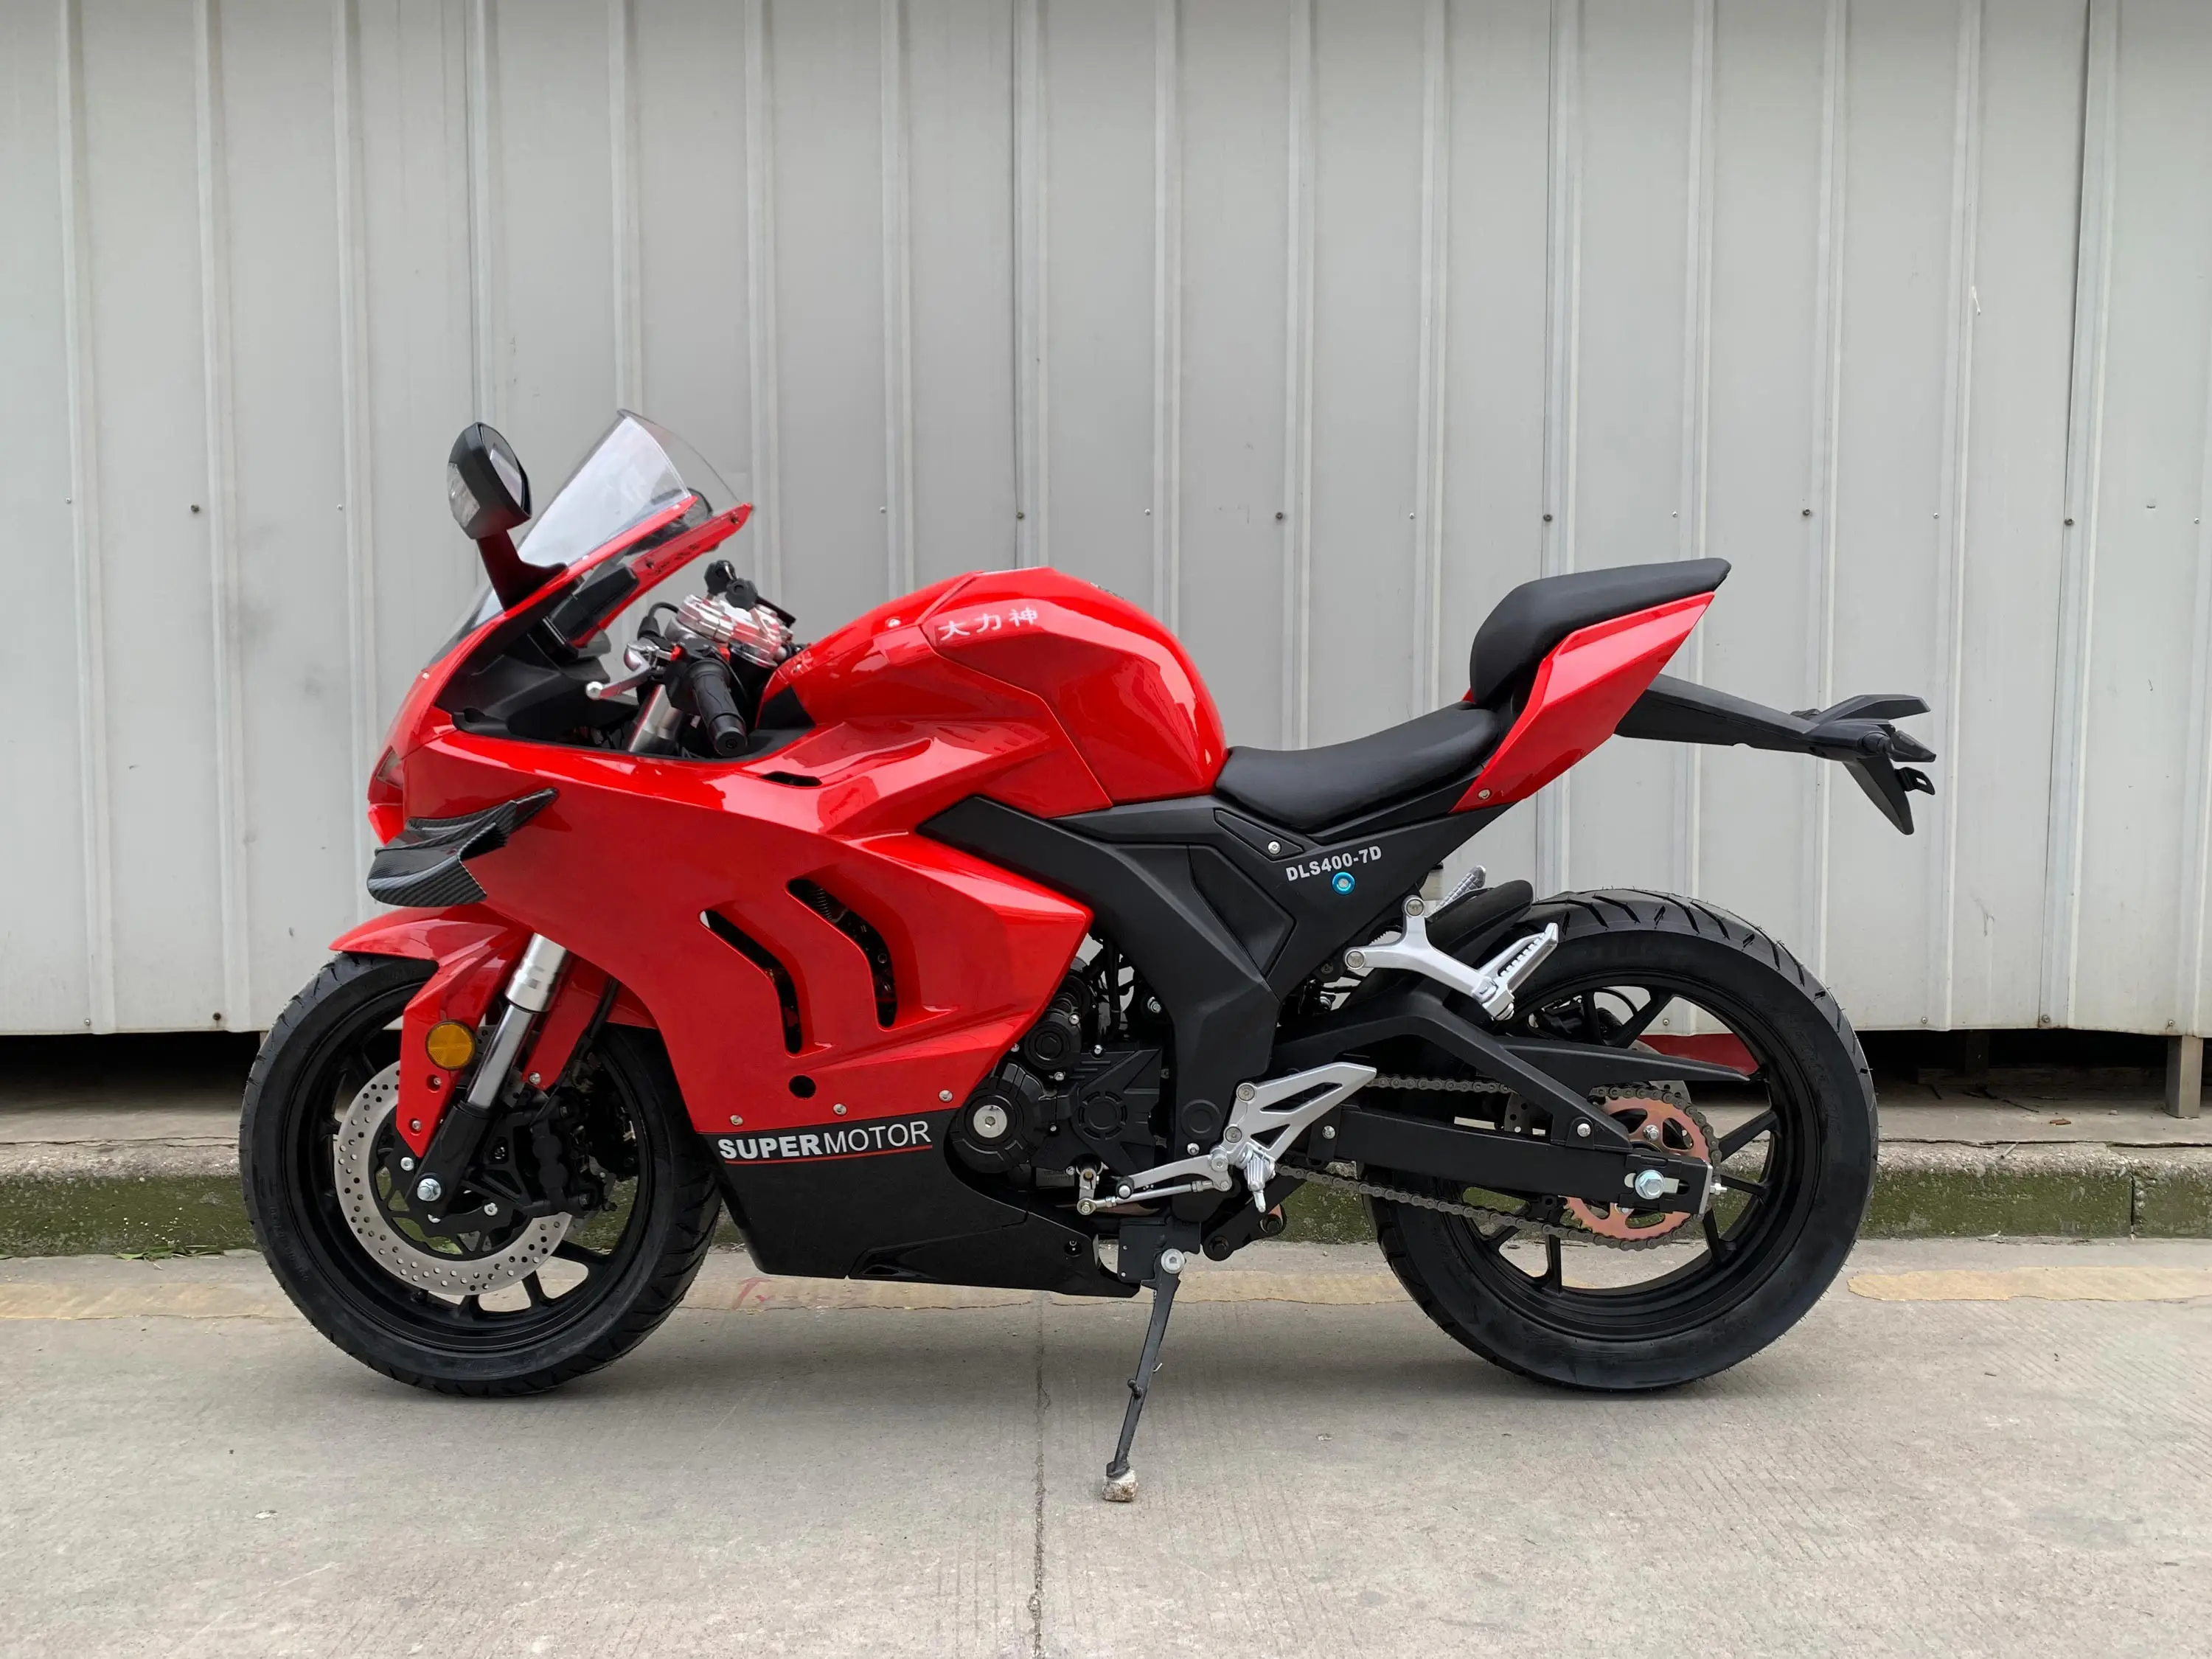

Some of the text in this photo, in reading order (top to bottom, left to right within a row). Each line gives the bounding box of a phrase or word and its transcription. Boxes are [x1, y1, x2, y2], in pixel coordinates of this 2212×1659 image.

[938, 607, 1038, 641] 大力神
[1286, 846, 1382, 881] DLS400-7D
[717, 1120, 931, 1159] SUPERMOTOR
